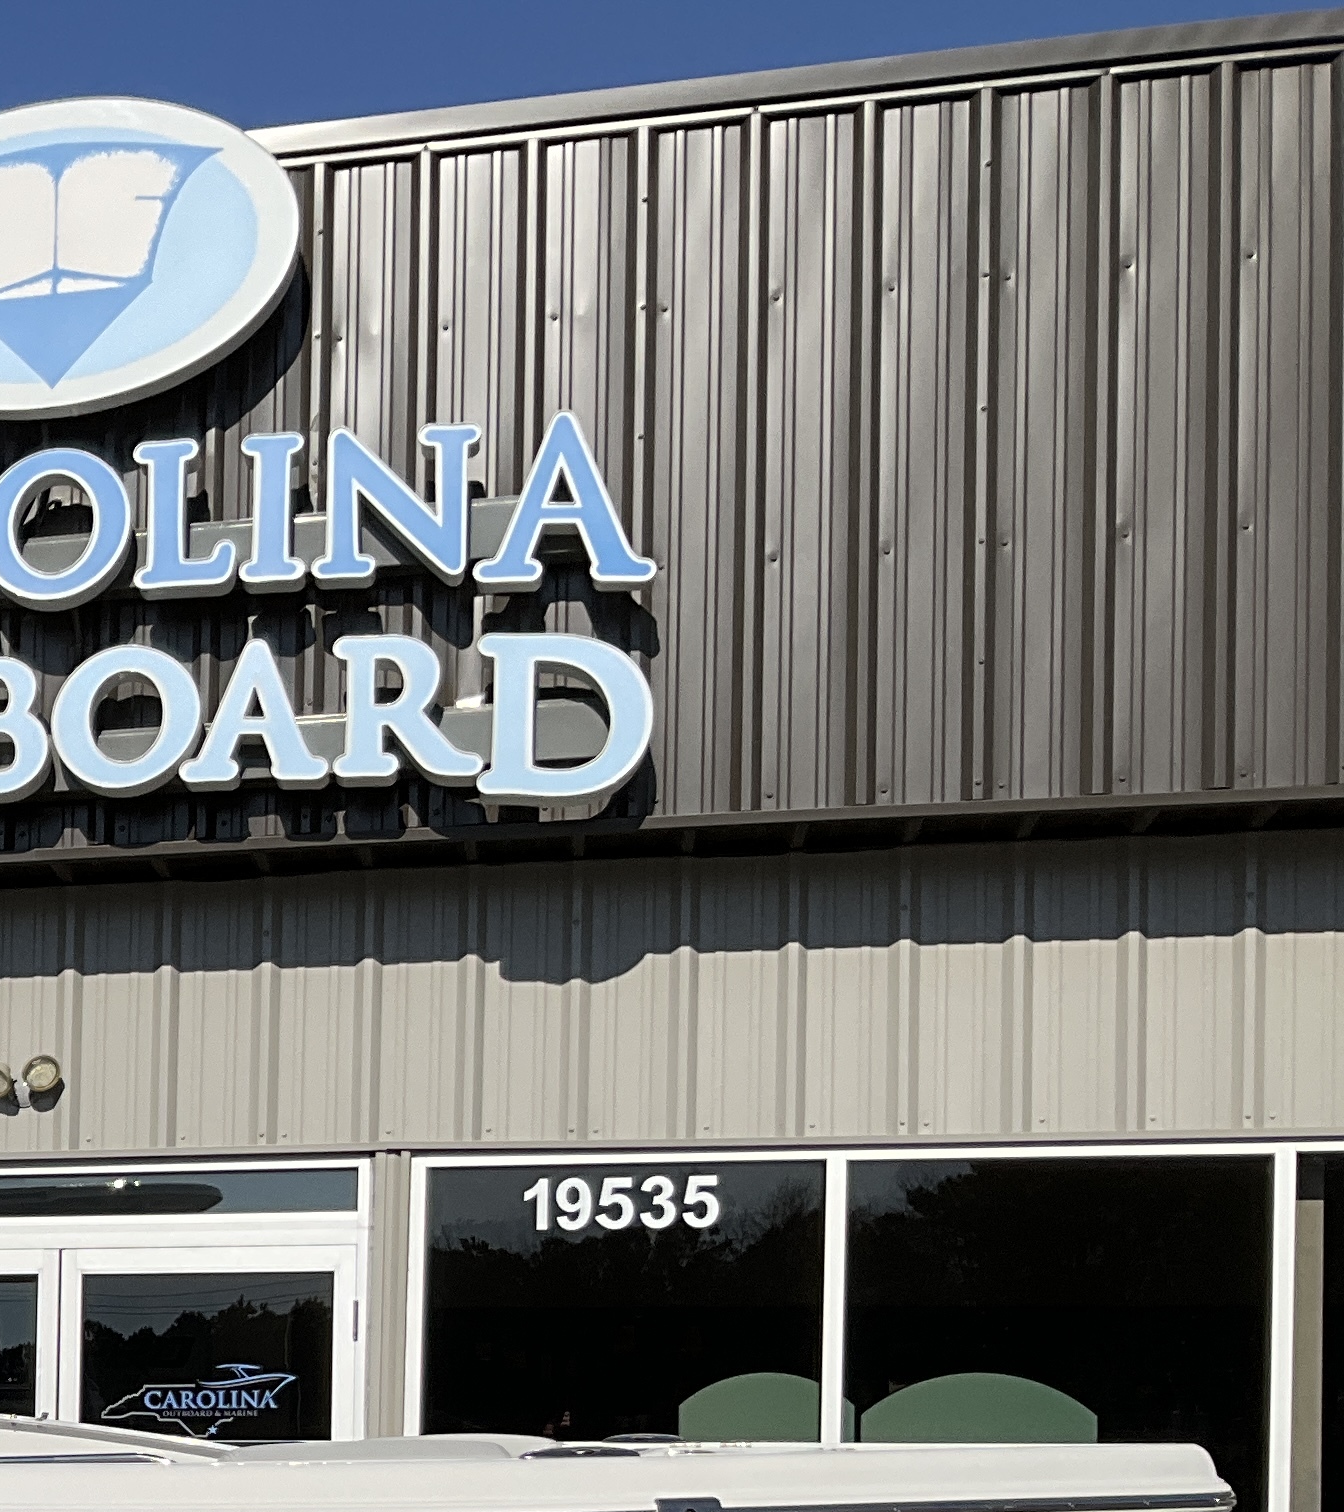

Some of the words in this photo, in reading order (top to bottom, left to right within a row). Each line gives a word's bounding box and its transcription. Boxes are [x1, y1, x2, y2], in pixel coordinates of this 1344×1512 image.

[523, 1174, 720, 1231] 19535
[143, 1389, 280, 1410] CAROLINA
[162, 1409, 213, 1417] OUTBOARD
[223, 1409, 259, 1417] MARINE
